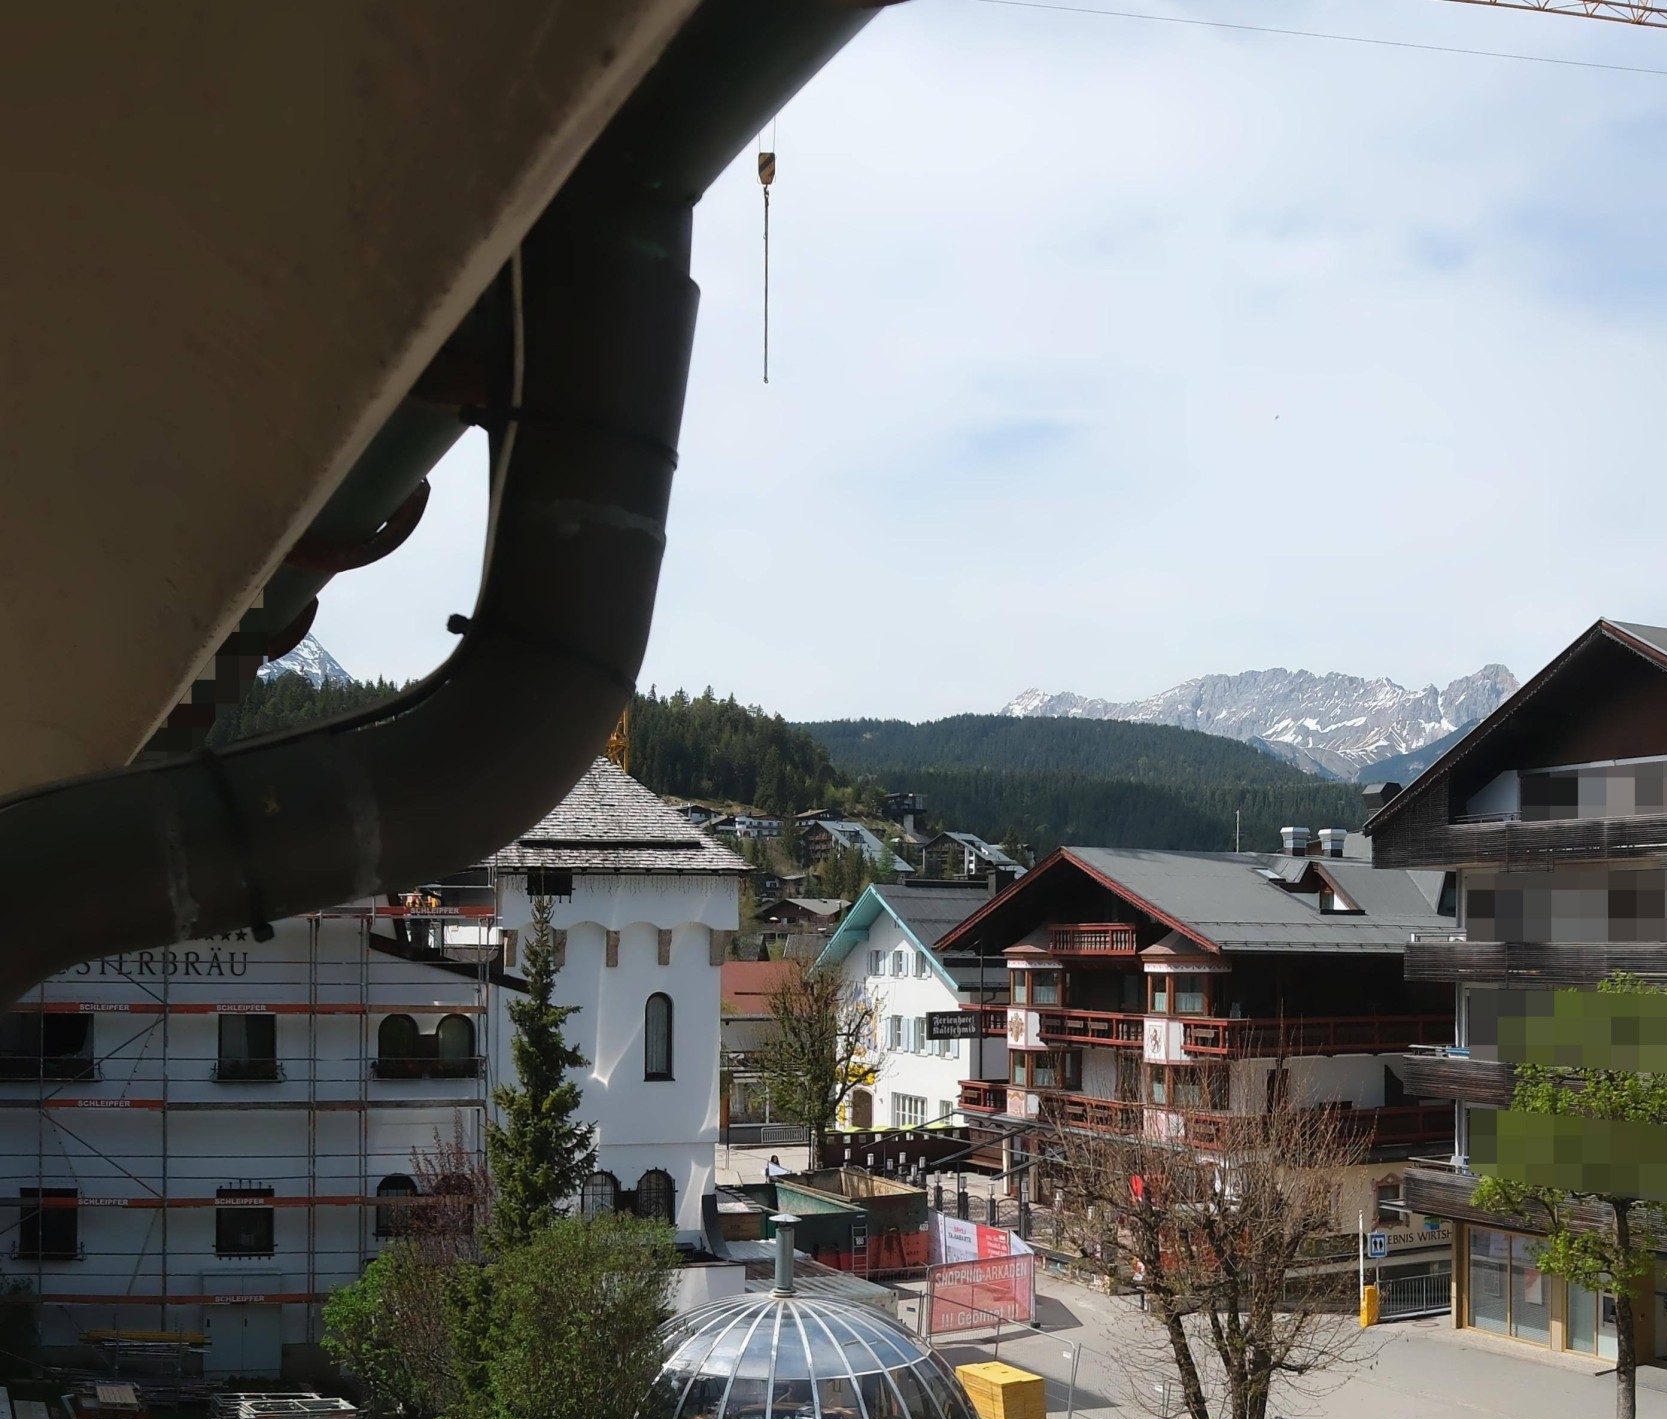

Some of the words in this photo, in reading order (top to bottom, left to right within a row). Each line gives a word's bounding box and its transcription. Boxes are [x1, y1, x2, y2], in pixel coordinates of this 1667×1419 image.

[79, 1003, 130, 1011] SCHLEIPFER
[932, 1014, 976, 1027] Ferienhotel
[77, 1100, 130, 1108] SCHLEIPFER
[78, 1198, 129, 1206] SCHLEIPFER
[214, 1197, 265, 1205] SCHLEIPFER
[1388, 1233, 1414, 1245] EBNIS
[935, 1262, 1028, 1288] SHOPPING-ARKADEN
[215, 1295, 265, 1303] SCHLEIPFER
